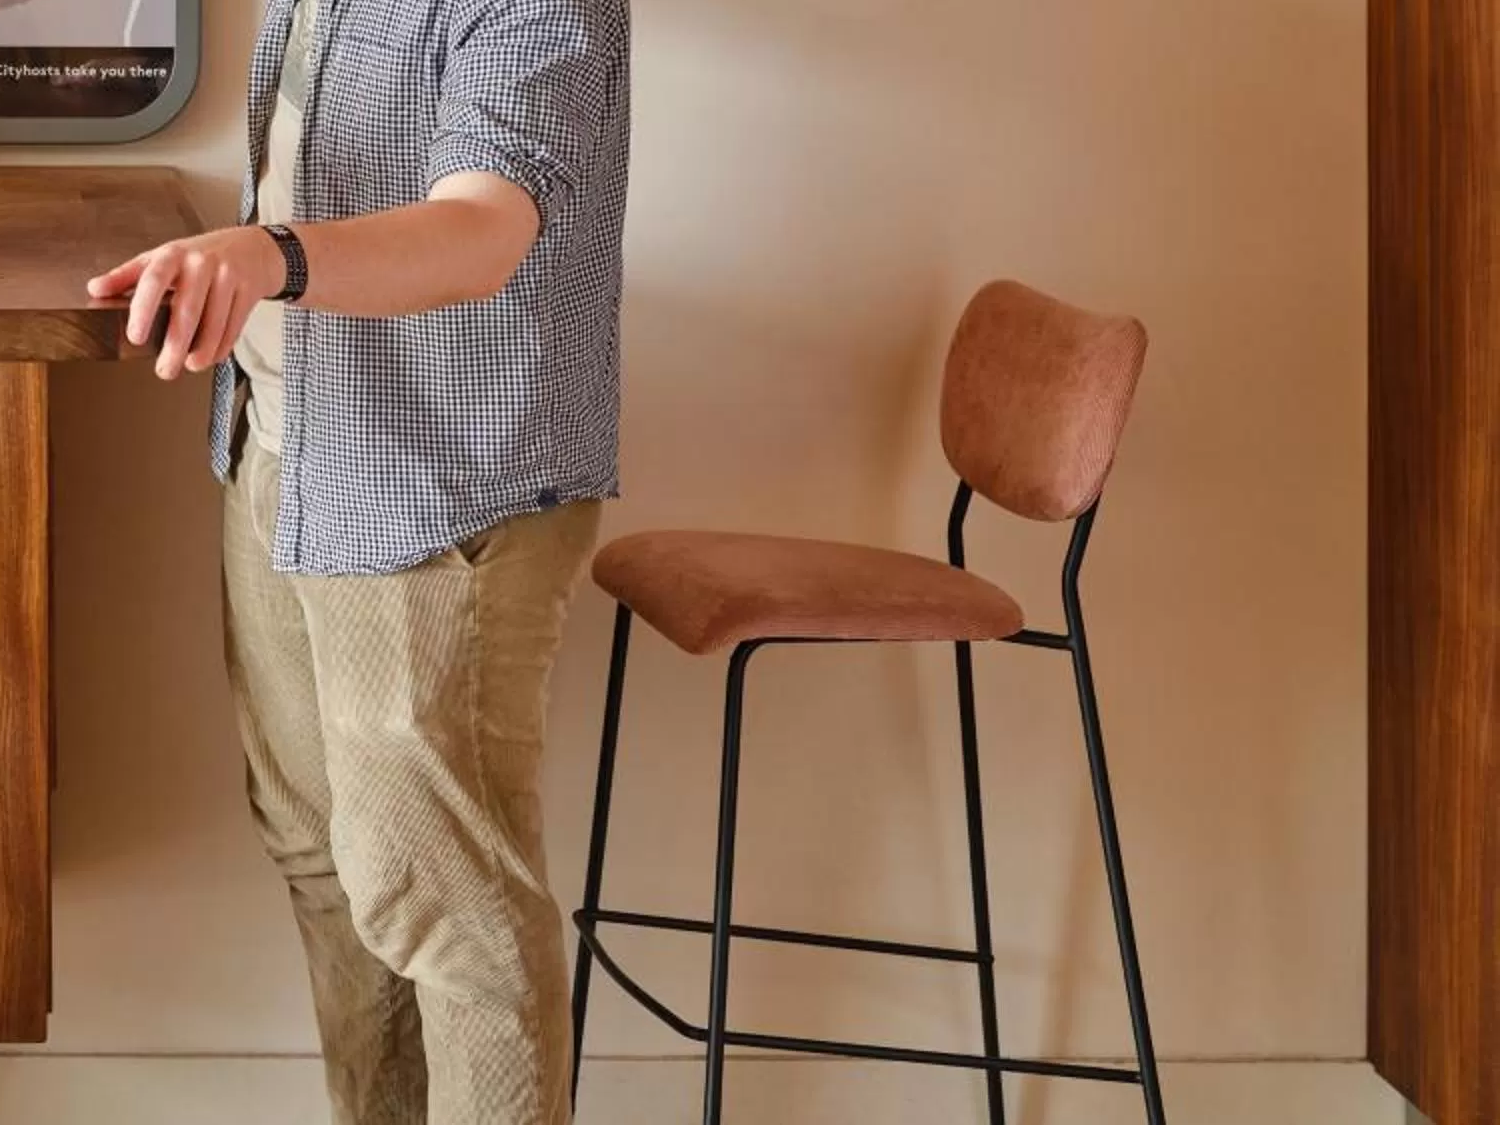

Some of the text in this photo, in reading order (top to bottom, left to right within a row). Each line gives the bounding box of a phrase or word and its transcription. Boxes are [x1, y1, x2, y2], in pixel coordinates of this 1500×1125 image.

[64, 64, 97, 77] take
[100, 66, 126, 80] you
[129, 64, 168, 77] there
